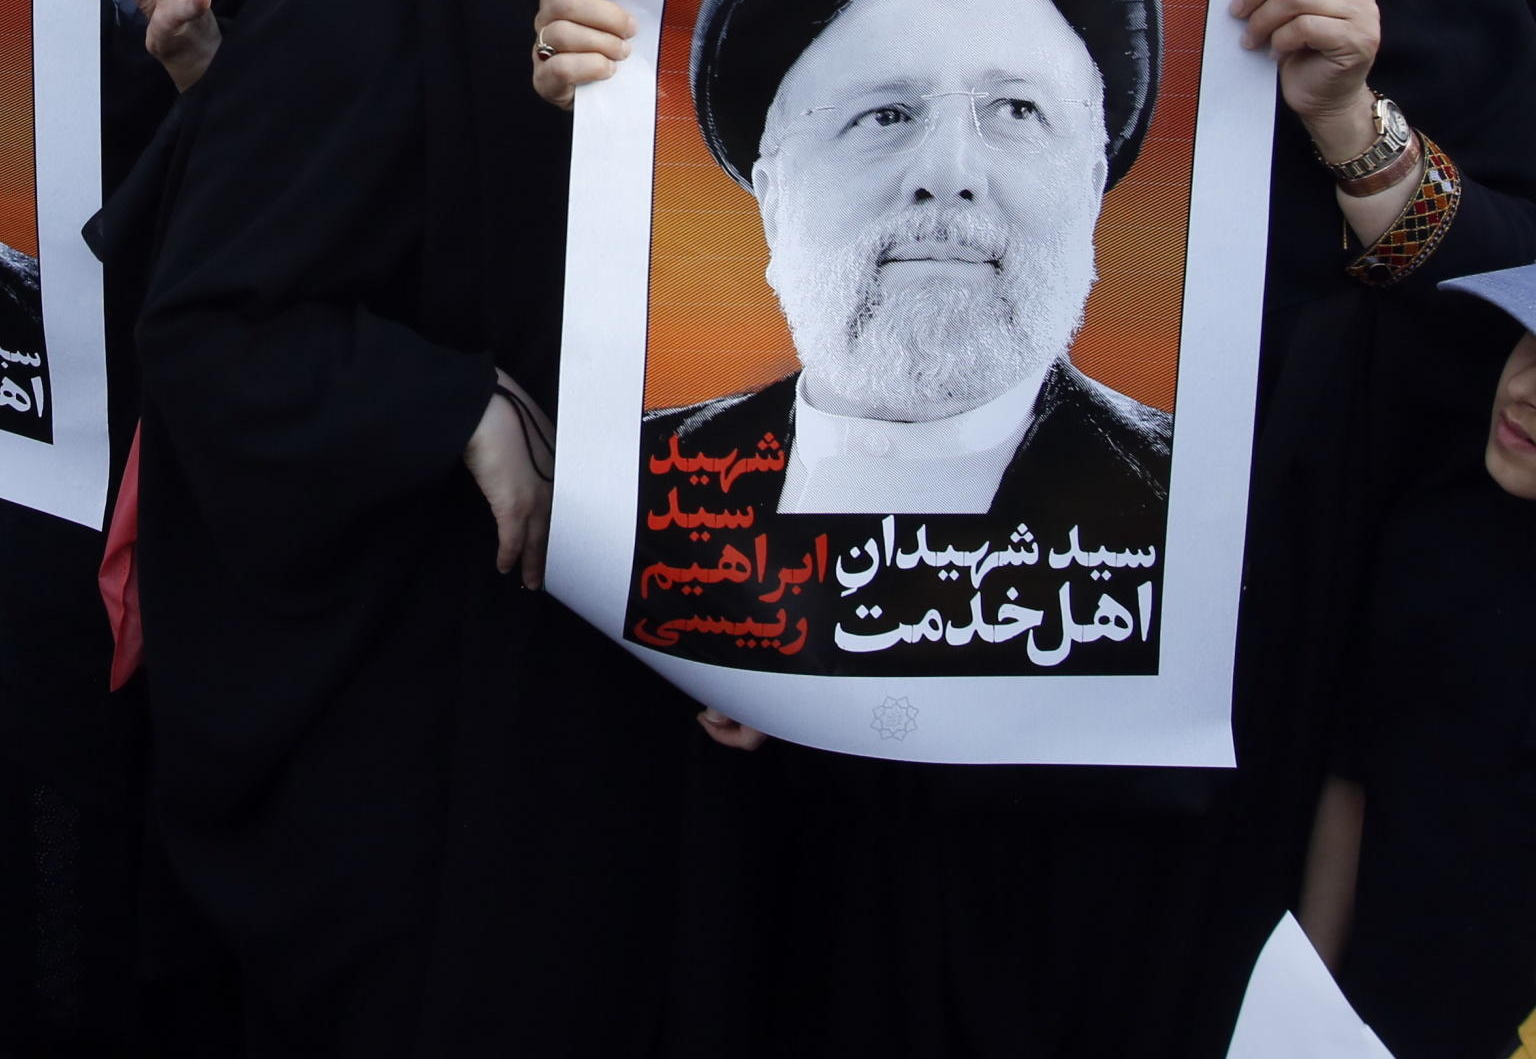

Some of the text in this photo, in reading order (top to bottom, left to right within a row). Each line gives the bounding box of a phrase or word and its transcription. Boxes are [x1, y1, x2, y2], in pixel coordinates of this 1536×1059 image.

[648, 431, 786, 494] شهید
[647, 486, 755, 542] سید
[640, 533, 828, 603] ابراهیم
[1048, 524, 1157, 580] سید
[833, 580, 1153, 667] اهل خدمت
